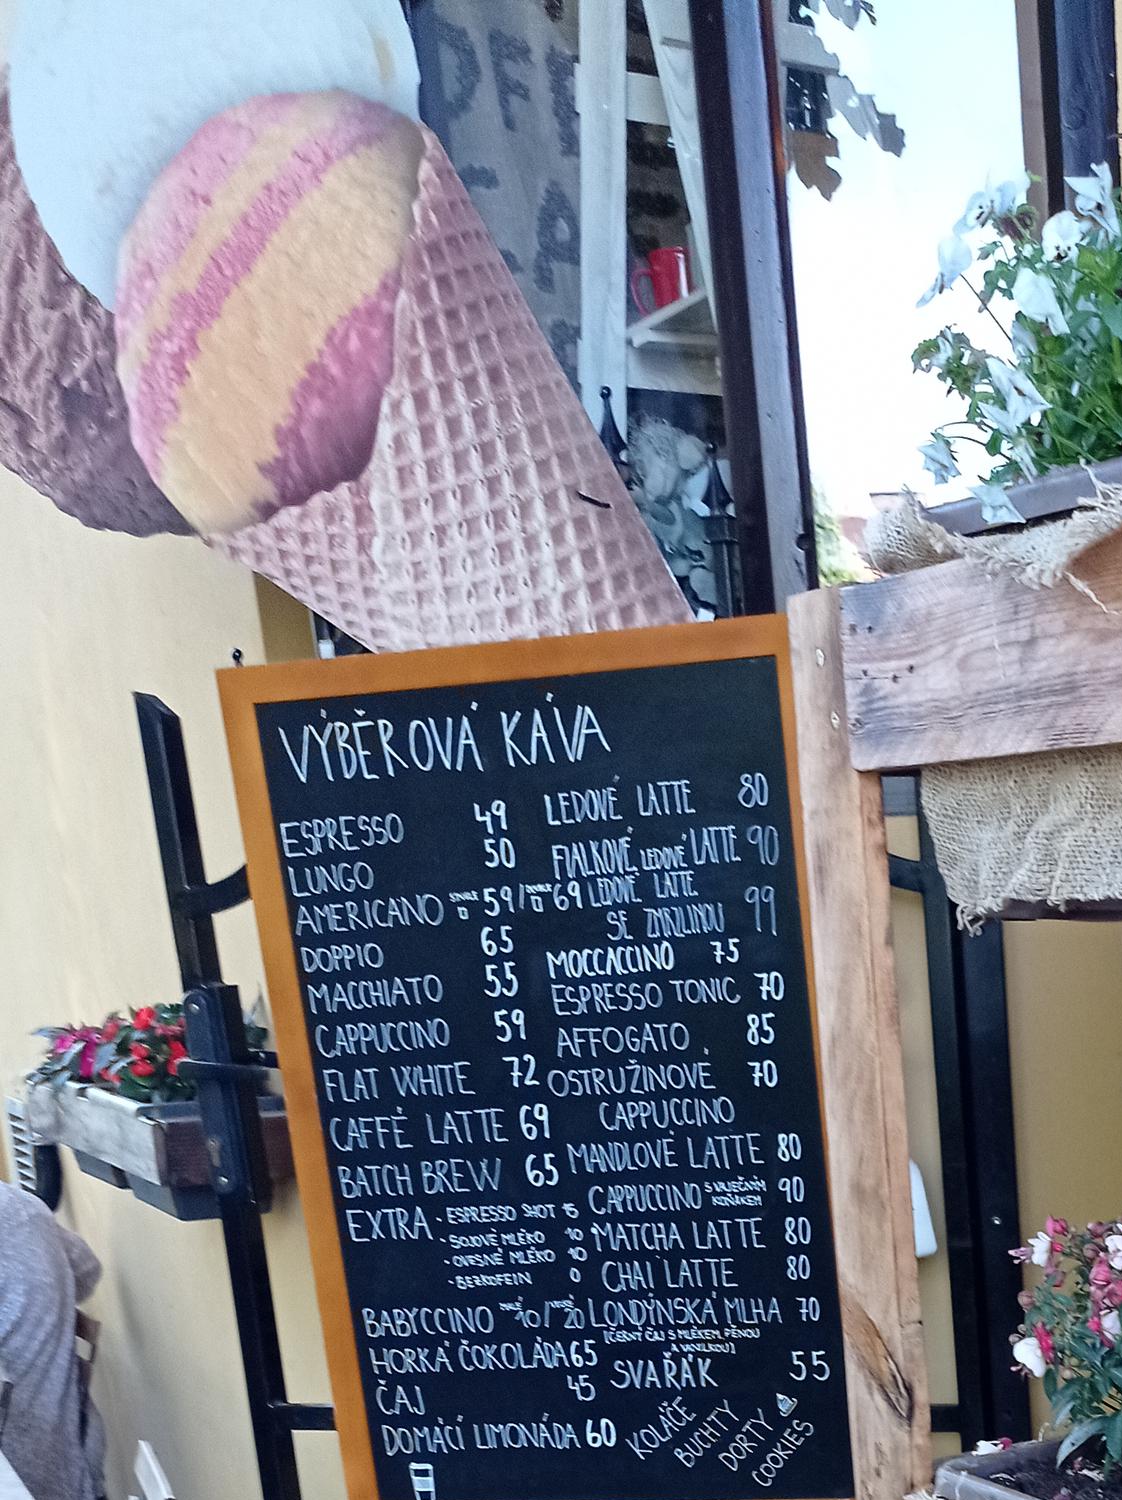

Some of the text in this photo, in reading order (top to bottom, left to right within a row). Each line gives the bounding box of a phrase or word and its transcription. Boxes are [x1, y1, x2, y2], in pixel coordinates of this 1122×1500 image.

[278, 692, 611, 783] VÝBĚROVÁ KÁVA
[544, 772, 769, 826] LEDOVÉ LATTE 80
[279, 800, 508, 858] ESPRESSO 49
[689, 825, 741, 865] LATTE
[746, 825, 780, 866] 90
[287, 837, 516, 898] LUNGO 50
[653, 870, 699, 899] LATTE
[295, 893, 445, 936] AMERICANO
[483, 885, 515, 916] 59
[553, 880, 583, 911] 69
[606, 910, 634, 941] SE
[744, 885, 778, 936] 99
[300, 925, 514, 973] DOPPIO 65
[546, 937, 740, 980] MOCCACCINO 75
[307, 961, 519, 1014] MACCHIATO 55
[551, 971, 785, 1016] ESPRESSO TONIC 70
[314, 1008, 526, 1058] CAPPUCCINO 59
[556, 1012, 775, 1059] AFFOGATO 85
[322, 1054, 541, 1103] FLAT WHITE 72
[547, 1047, 779, 1097] OSTRUŽINOVÉ 70
[425, 1108, 509, 1144] LATTE
[519, 1103, 551, 1141] 69
[599, 1095, 736, 1131] CAPPUCCINO
[566, 1129, 802, 1175] MANDLOVÉ LATTE 80
[337, 1153, 559, 1198] BATCH BREW 65
[587, 1181, 702, 1215] CAPPUCCINO
[778, 1175, 805, 1203] 90
[348, 1206, 434, 1242] EXTRA
[446, 1205, 517, 1224] ESPRESSO
[591, 1216, 812, 1251] MATCHA LATTE 80
[569, 1267, 582, 1283] 0
[601, 1254, 811, 1292] CHAI LATTE 80
[362, 1306, 495, 1338] BABYCCINO
[563, 1308, 585, 1329] 20
[588, 1291, 821, 1328] LONDÝNSKÁ MLHA 70
[369, 1336, 598, 1375] HORKÁ ČOKOLÁDA 65
[609, 1350, 831, 1391] SVAŘÁK 55
[376, 1374, 596, 1416] ČAJ 45
[381, 1412, 617, 1457] DOMÁCÍ LIMONÁDA 60
[625, 1395, 697, 1460] KOLÁČE
[674, 1398, 739, 1468] BUCHTY
[717, 1407, 774, 1472] DORTY
[751, 1419, 814, 1487] COOKIES
